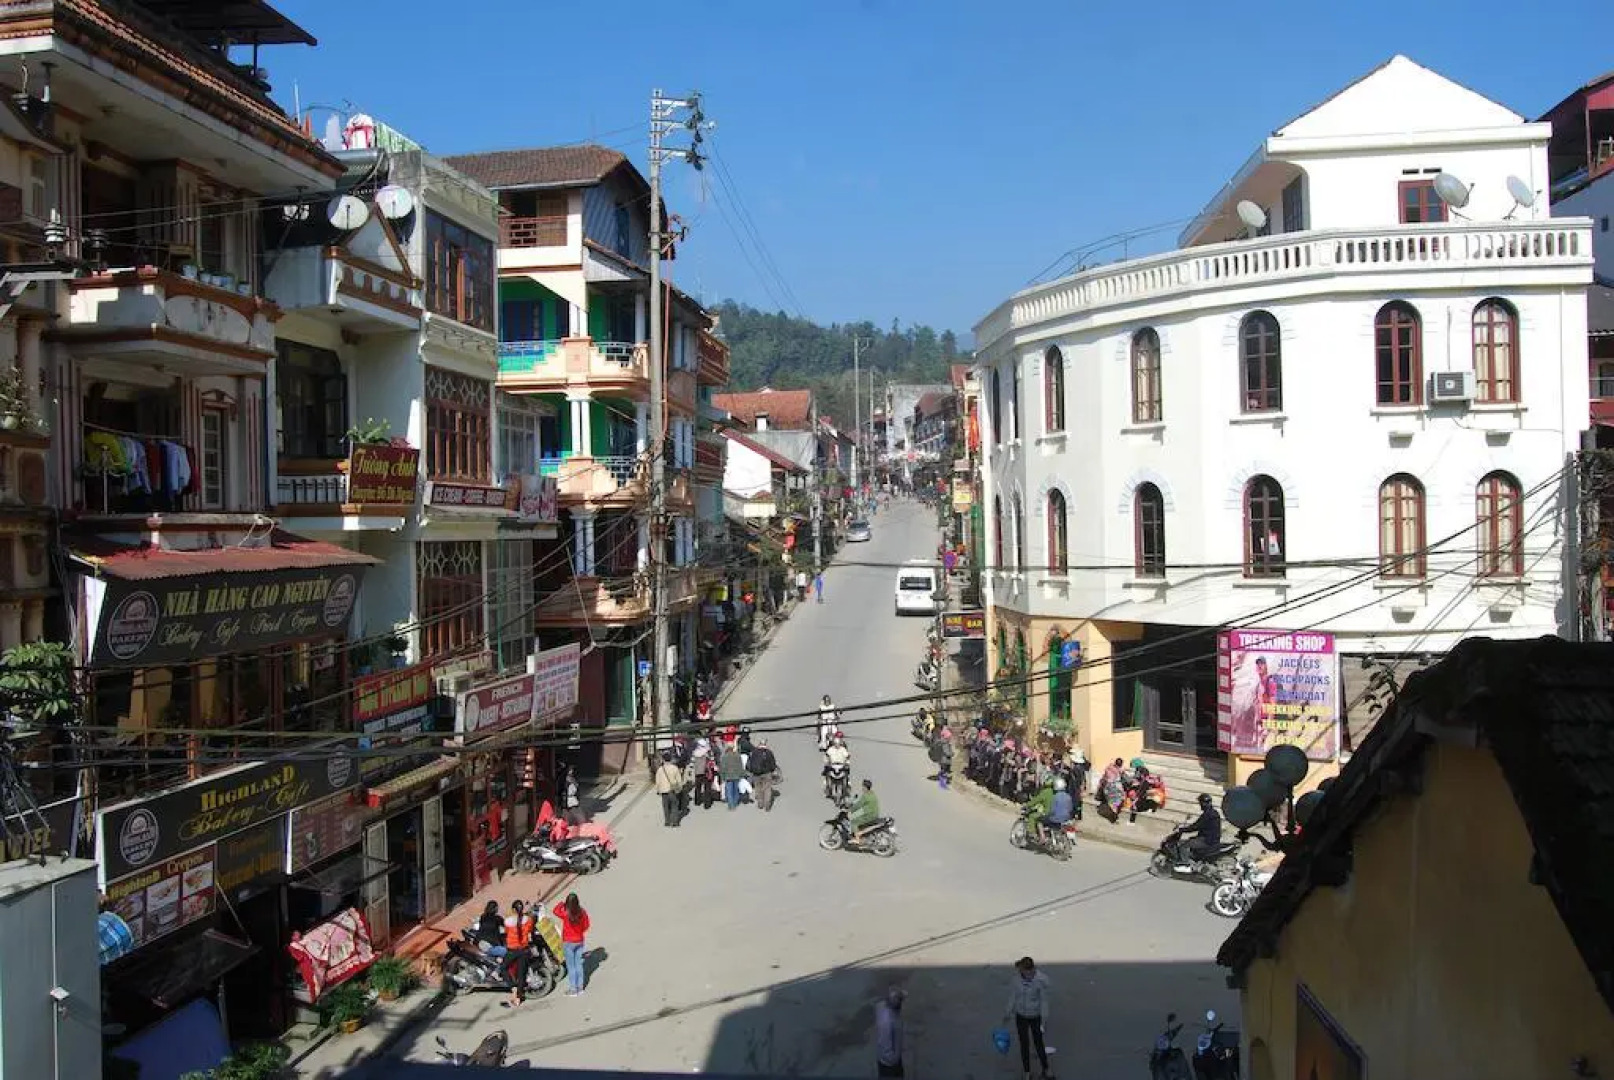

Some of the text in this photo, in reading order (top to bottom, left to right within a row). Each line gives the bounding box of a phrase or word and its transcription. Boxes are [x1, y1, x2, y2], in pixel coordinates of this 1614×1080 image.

[250, 581, 279, 608] CAO
[1239, 633, 1326, 651] TREKKING SHOP
[1278, 658, 1320, 668] JACKETS
